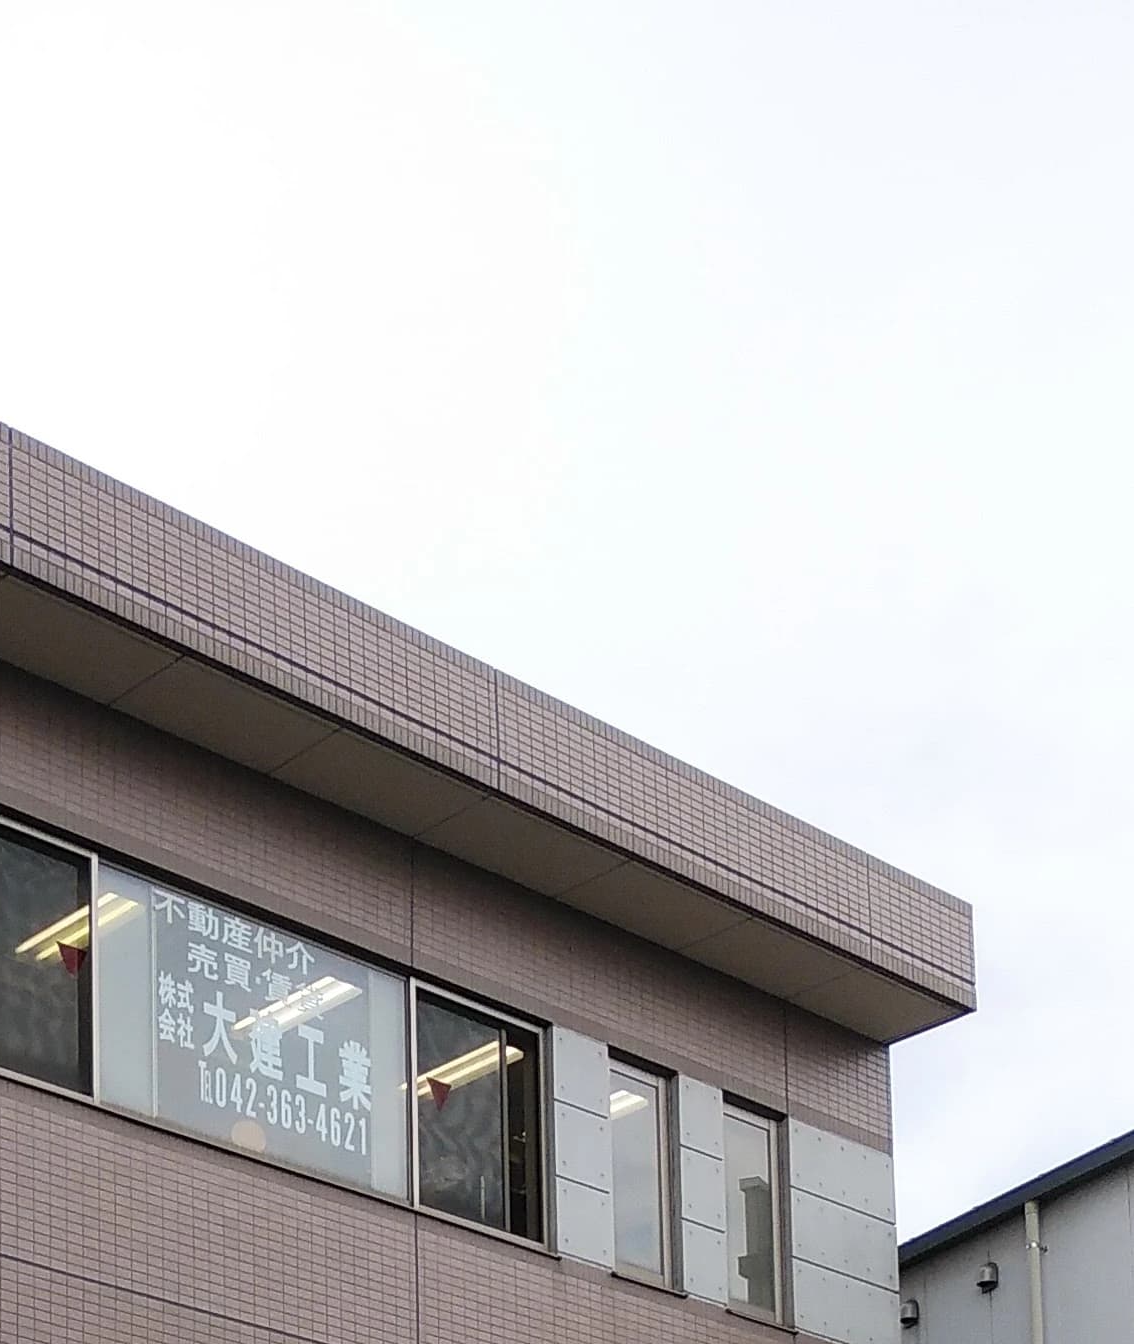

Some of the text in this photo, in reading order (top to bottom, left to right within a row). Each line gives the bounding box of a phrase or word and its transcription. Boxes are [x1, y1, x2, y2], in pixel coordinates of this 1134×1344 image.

[154, 889, 315, 975] 不動産仲介
[202, 991, 373, 1112] 大建工業
